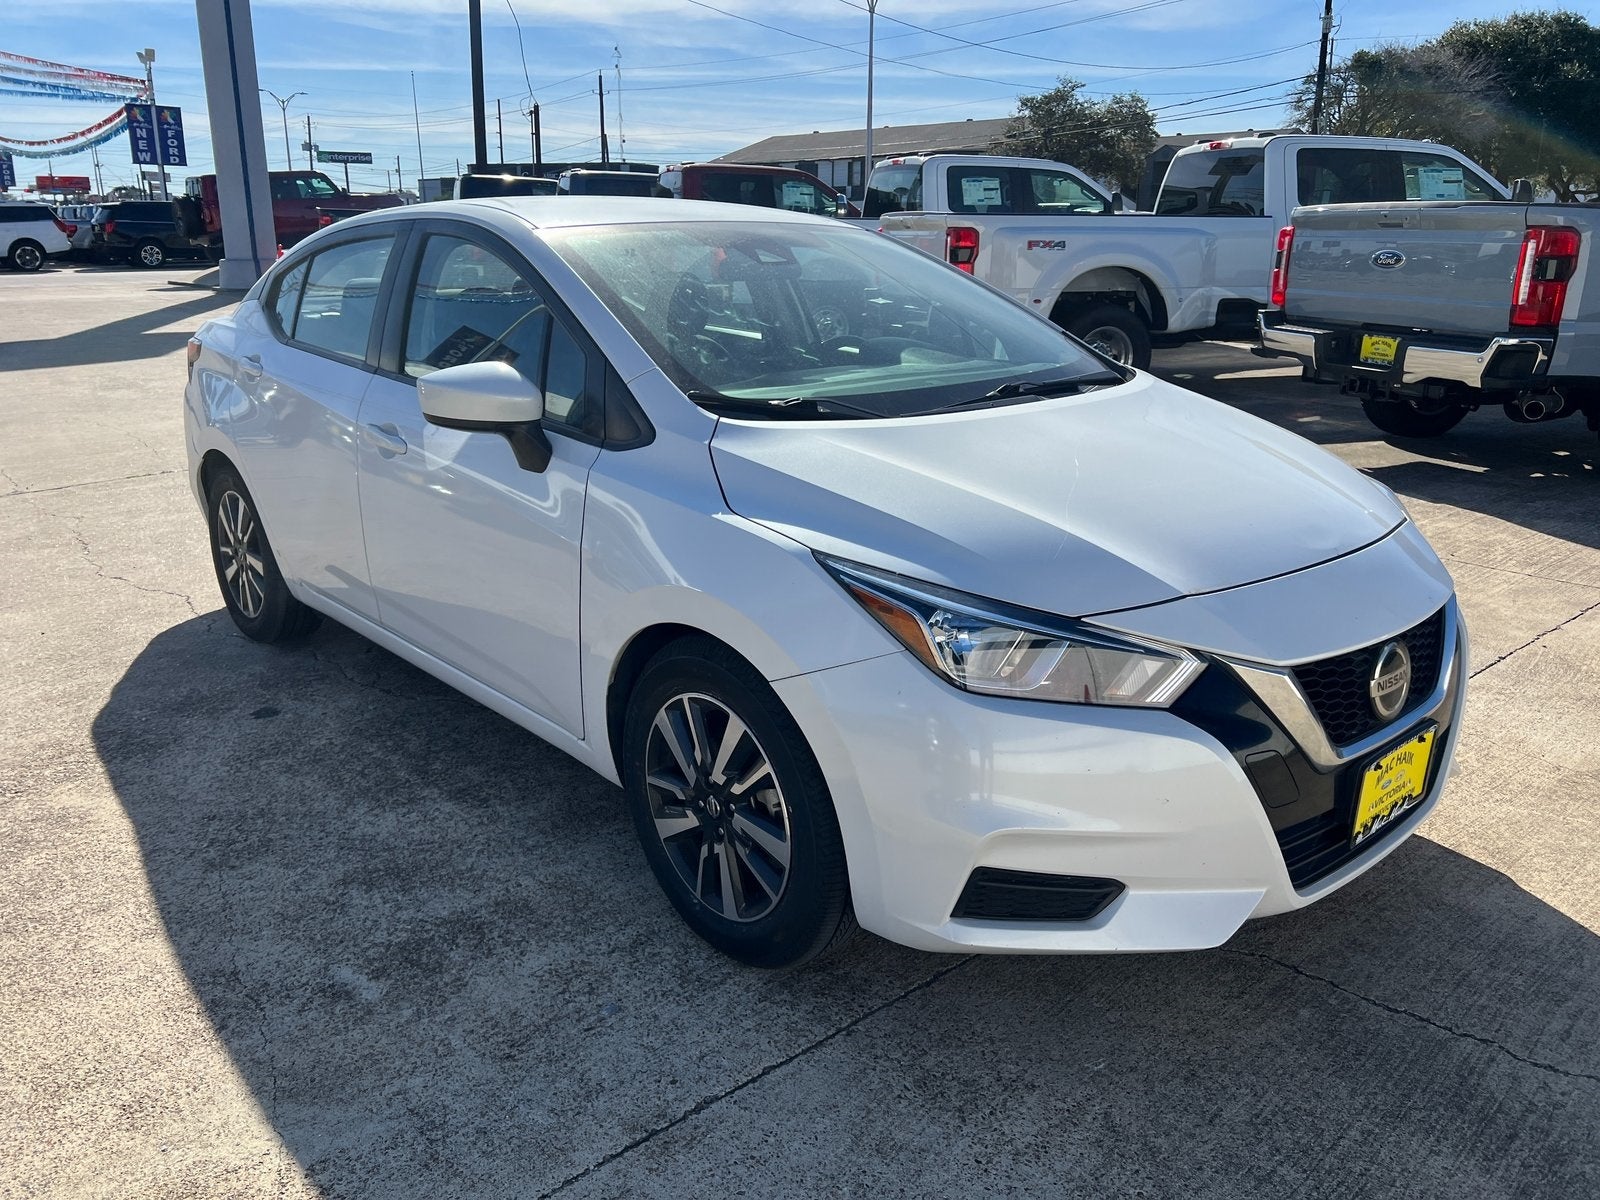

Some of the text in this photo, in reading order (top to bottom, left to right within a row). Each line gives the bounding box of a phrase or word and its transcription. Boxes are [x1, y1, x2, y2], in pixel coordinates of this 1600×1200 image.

[136, 128, 151, 162] NEW
[167, 130, 179, 164] FORD
[319, 153, 372, 162] enterprise
[2, 164, 11, 186] FORD
[1027, 240, 1066, 251] FX4
[1377, 253, 1397, 265] Ford
[1377, 670, 1407, 692] NISSAN
[1375, 757, 1395, 789] MAC
[1396, 751, 1414, 767] HAIK
[1374, 780, 1406, 808] VICTORIA
